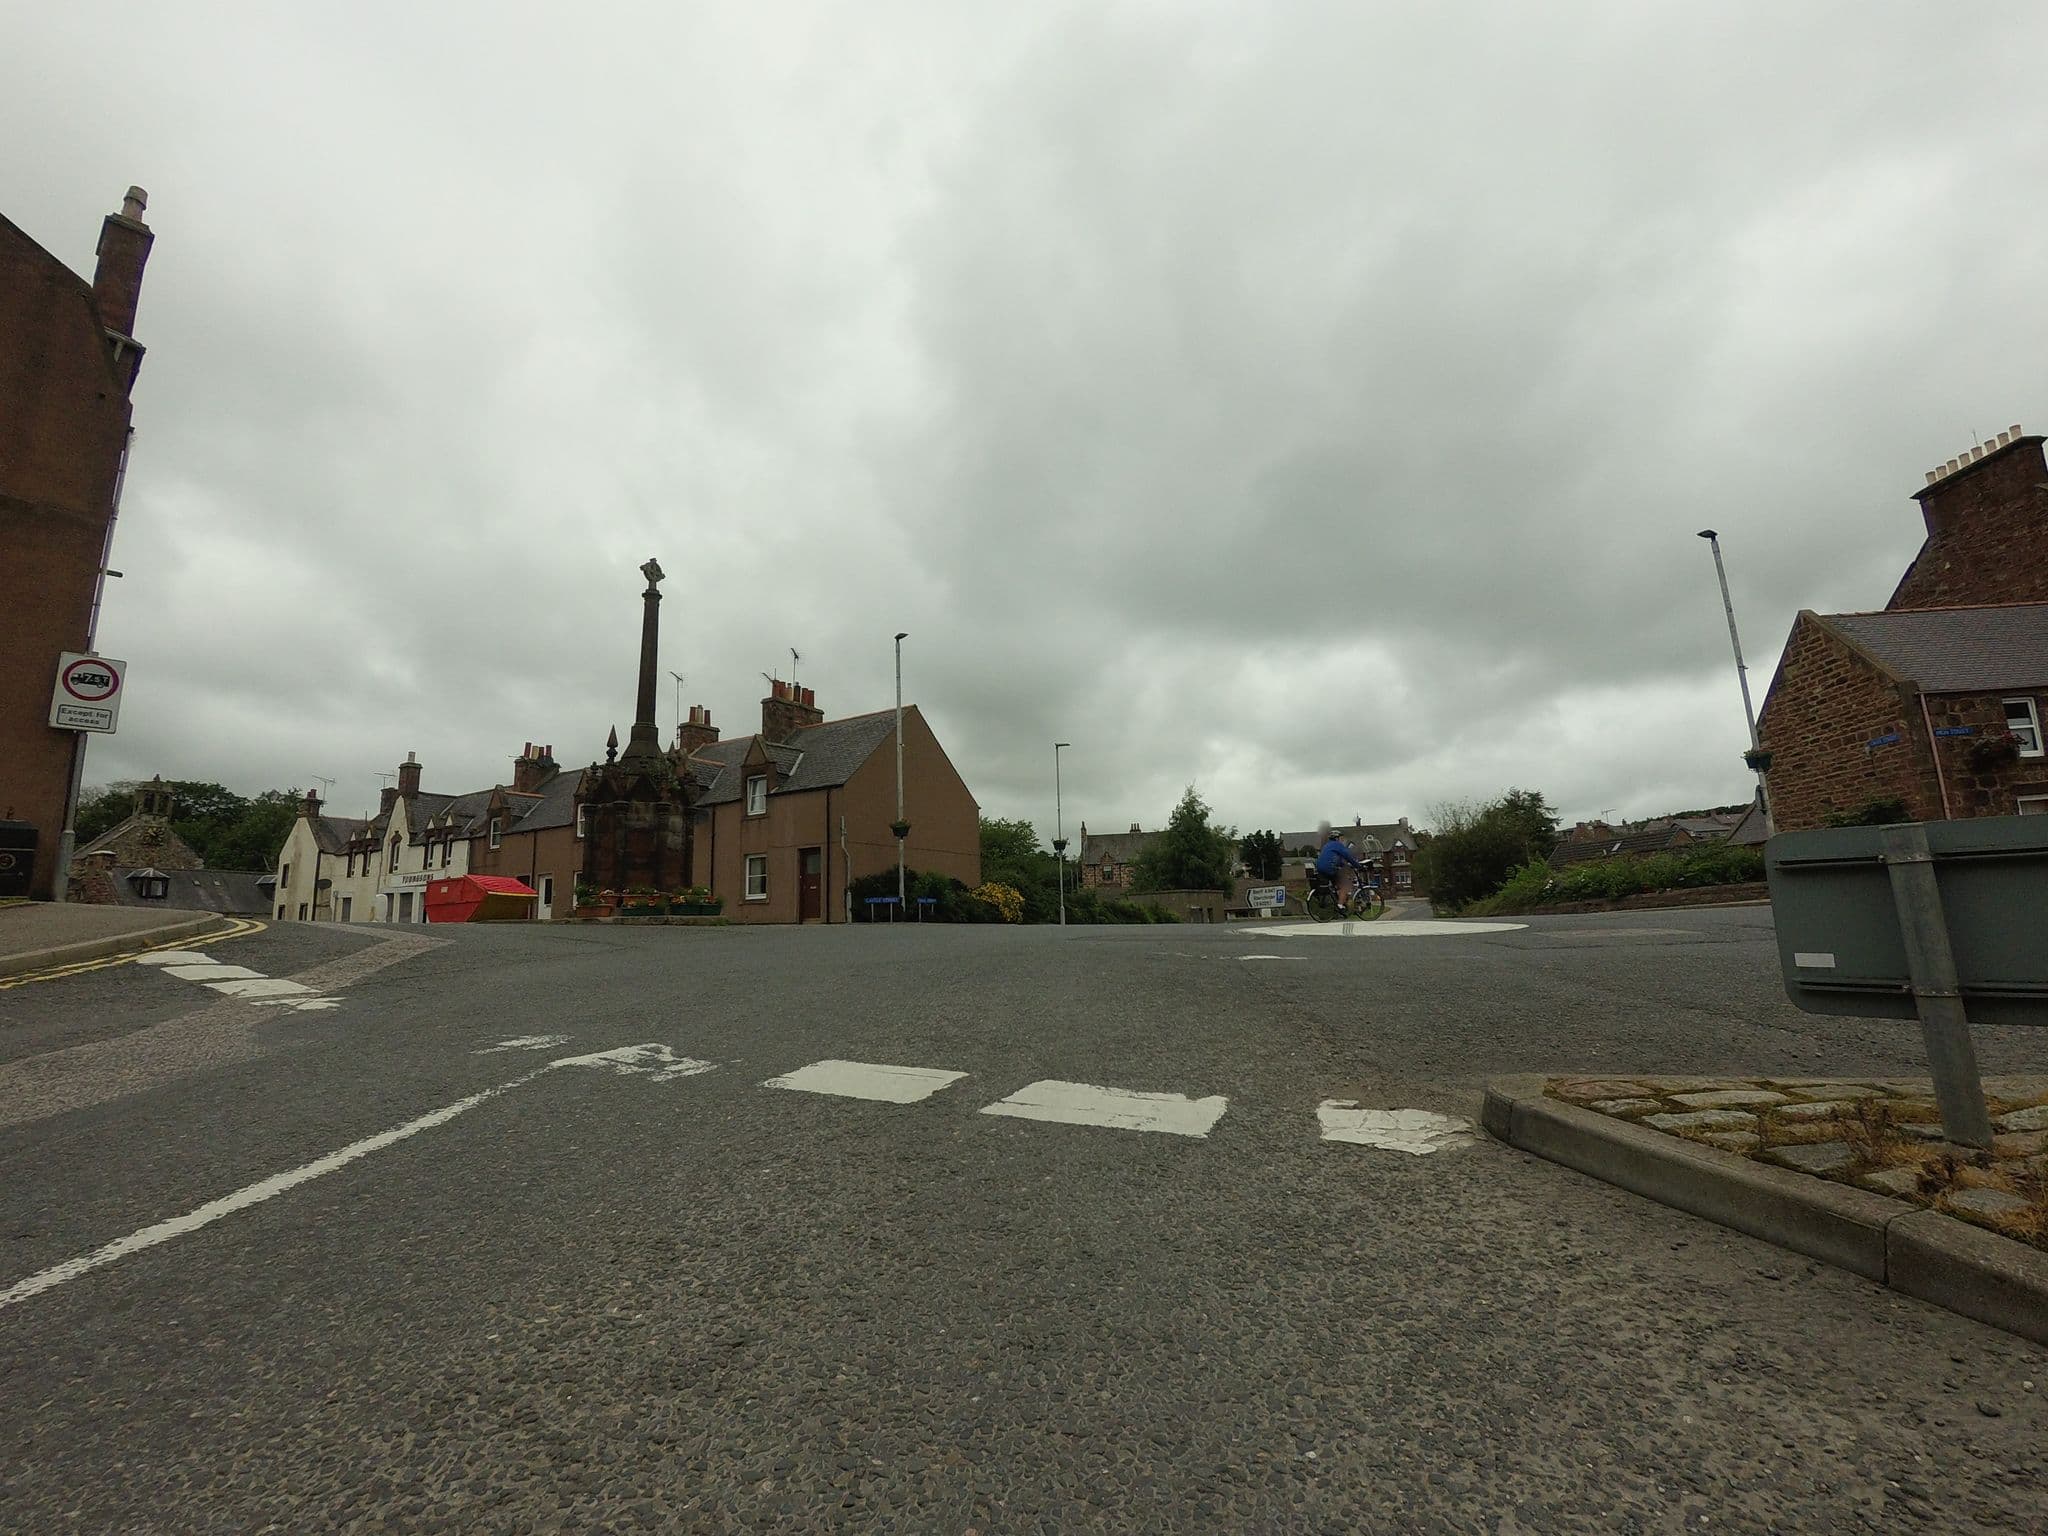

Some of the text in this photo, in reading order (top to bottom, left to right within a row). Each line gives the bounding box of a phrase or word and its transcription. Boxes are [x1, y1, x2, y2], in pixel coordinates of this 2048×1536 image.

[61, 708, 109, 719] Except for
[68, 717, 100, 725] access
